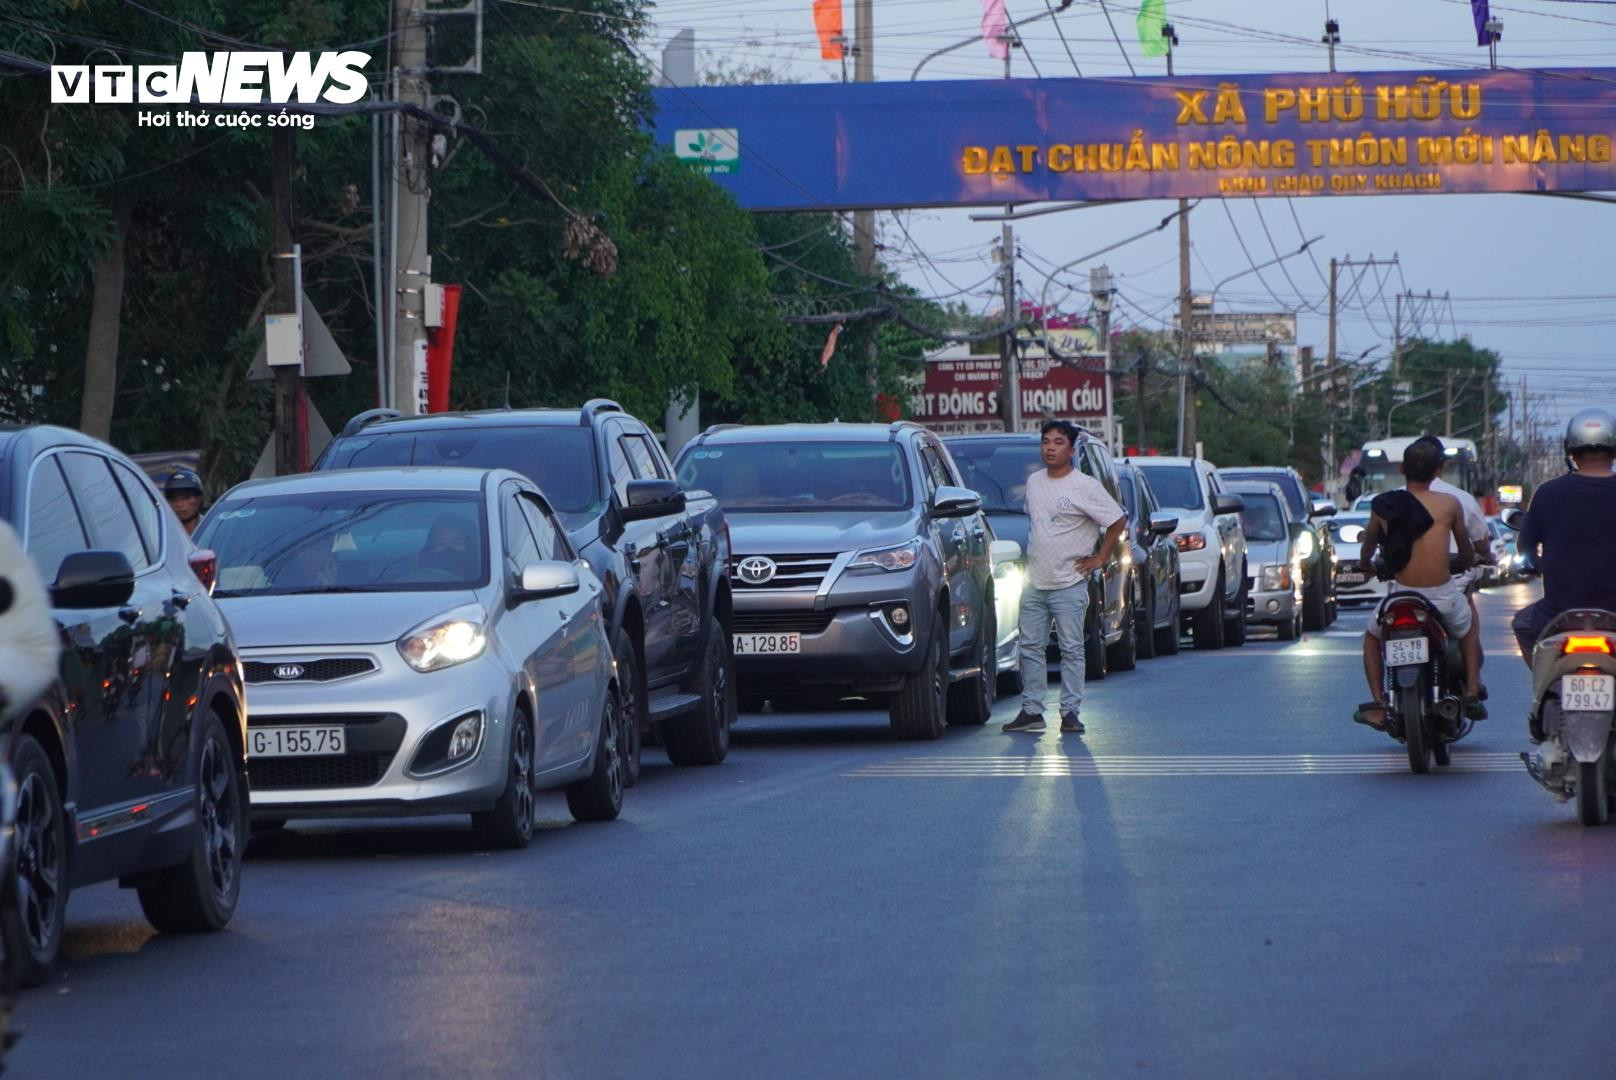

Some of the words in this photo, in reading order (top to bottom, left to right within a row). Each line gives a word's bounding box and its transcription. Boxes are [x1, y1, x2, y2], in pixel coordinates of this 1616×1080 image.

[1175, 82, 1246, 125] XÃ
[1264, 79, 1364, 123] PHÚ
[1375, 76, 1482, 121] HỮU
[962, 145, 1038, 180] ĐẠT
[1048, 128, 1179, 172] CHUẨN
[1189, 134, 1296, 170] NÔNG
[1306, 131, 1408, 167] THÔN
[1417, 127, 1493, 165] MỚI
[1503, 129, 1612, 163] NÂNG
[938, 387, 985, 419] ĐỘNG
[1022, 383, 1067, 413] HOÀN
[735, 635, 798, 652] A-129.85
[278, 666, 300, 677] KIA
